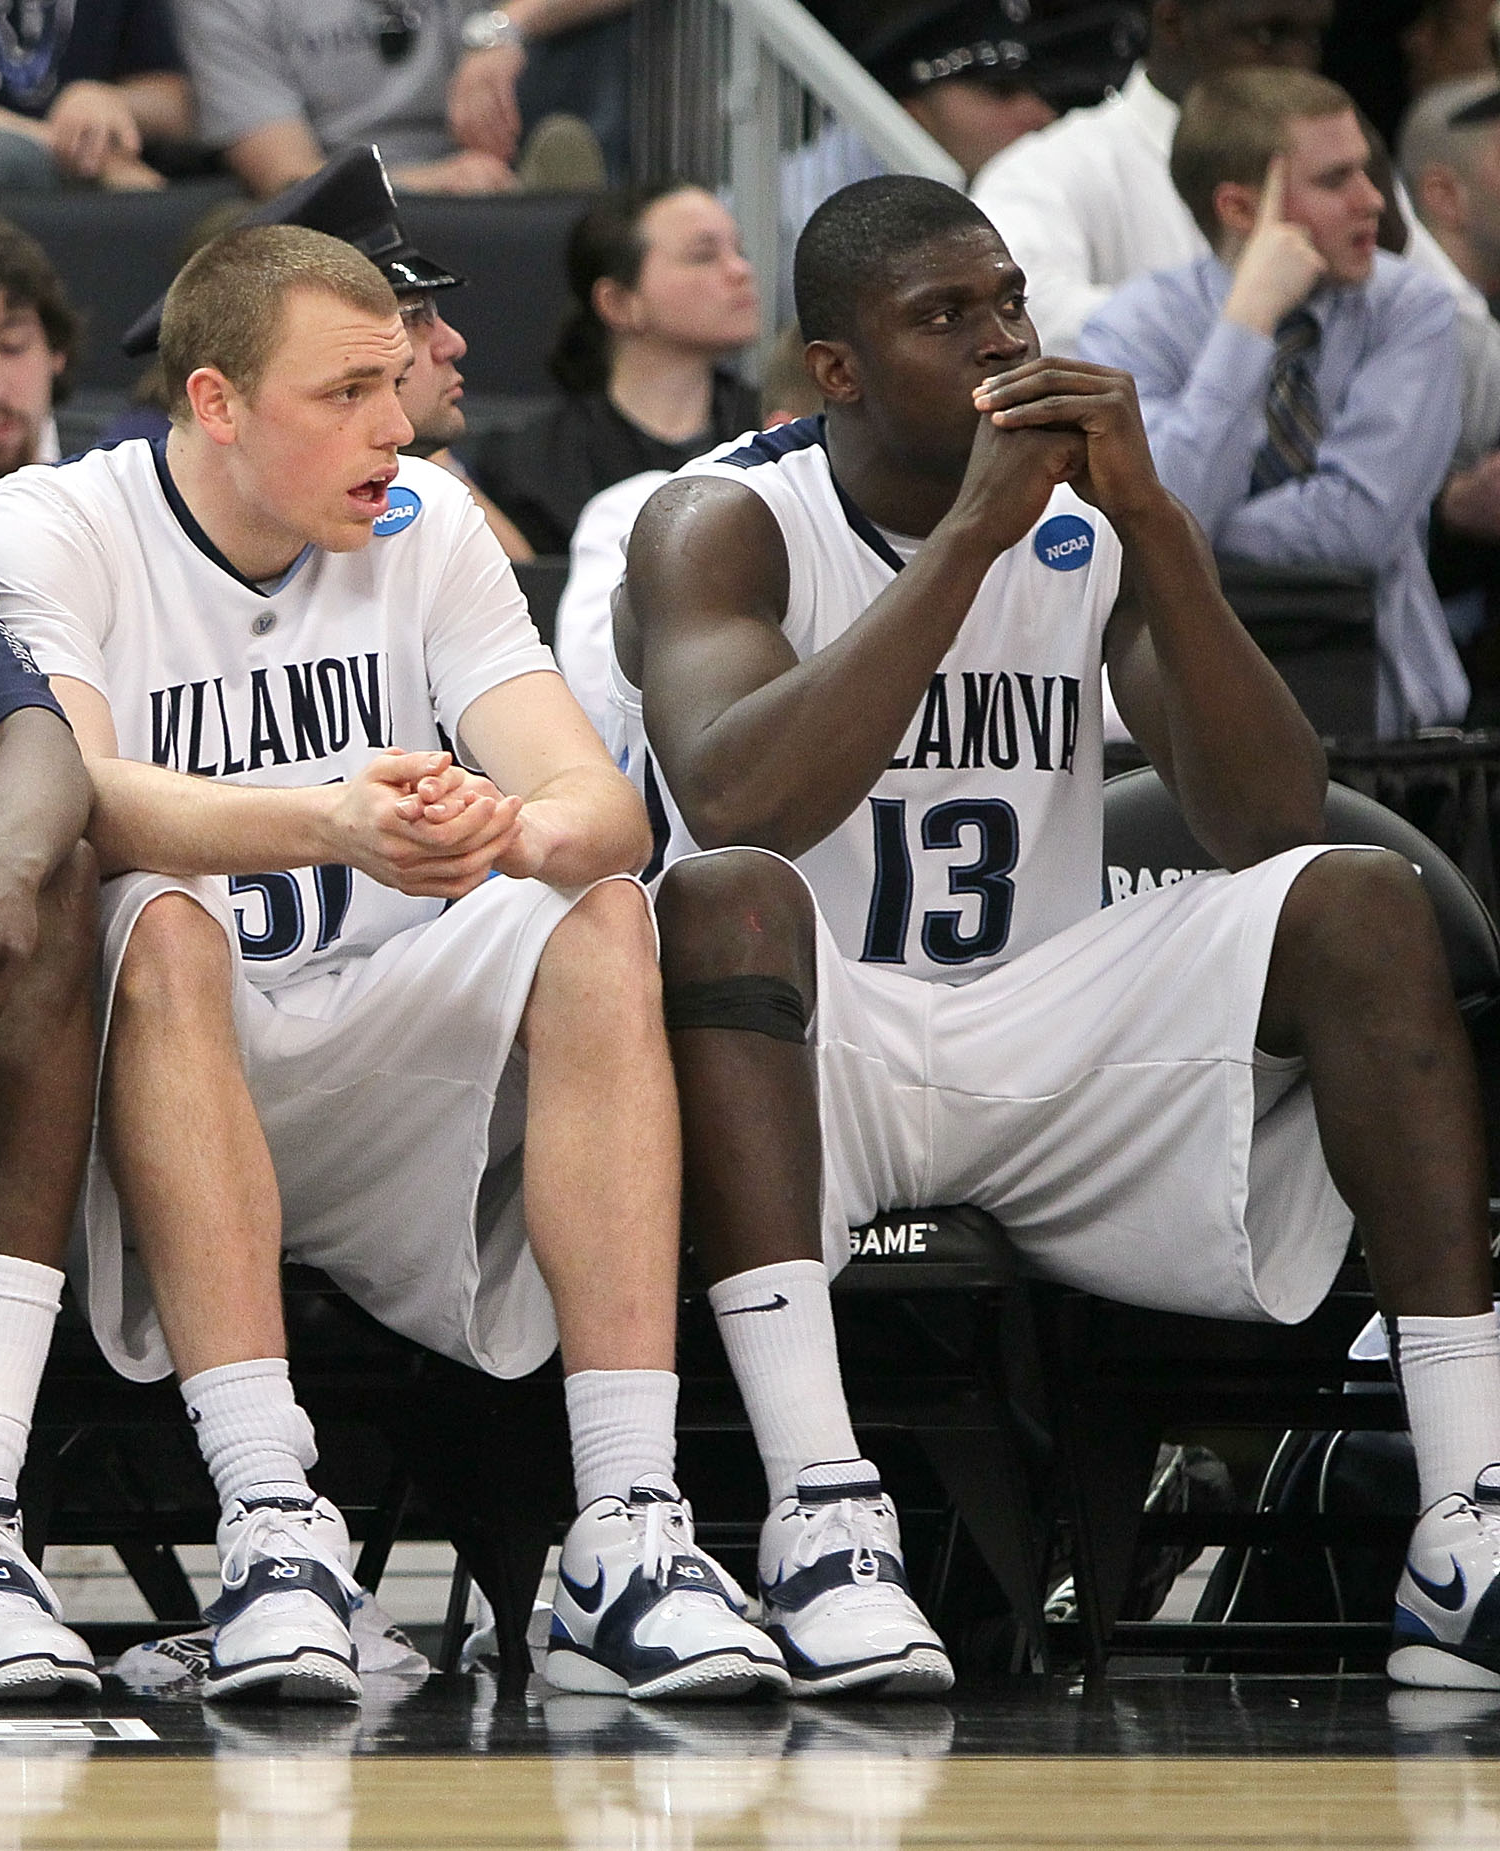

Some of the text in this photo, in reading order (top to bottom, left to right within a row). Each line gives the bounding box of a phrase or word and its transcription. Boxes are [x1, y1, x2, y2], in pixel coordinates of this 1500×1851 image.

[373, 505, 415, 526] NCAA
[1045, 534, 1090, 561] NCAA
[149, 652, 394, 778] VILLANOV
[858, 796, 1020, 965] 13
